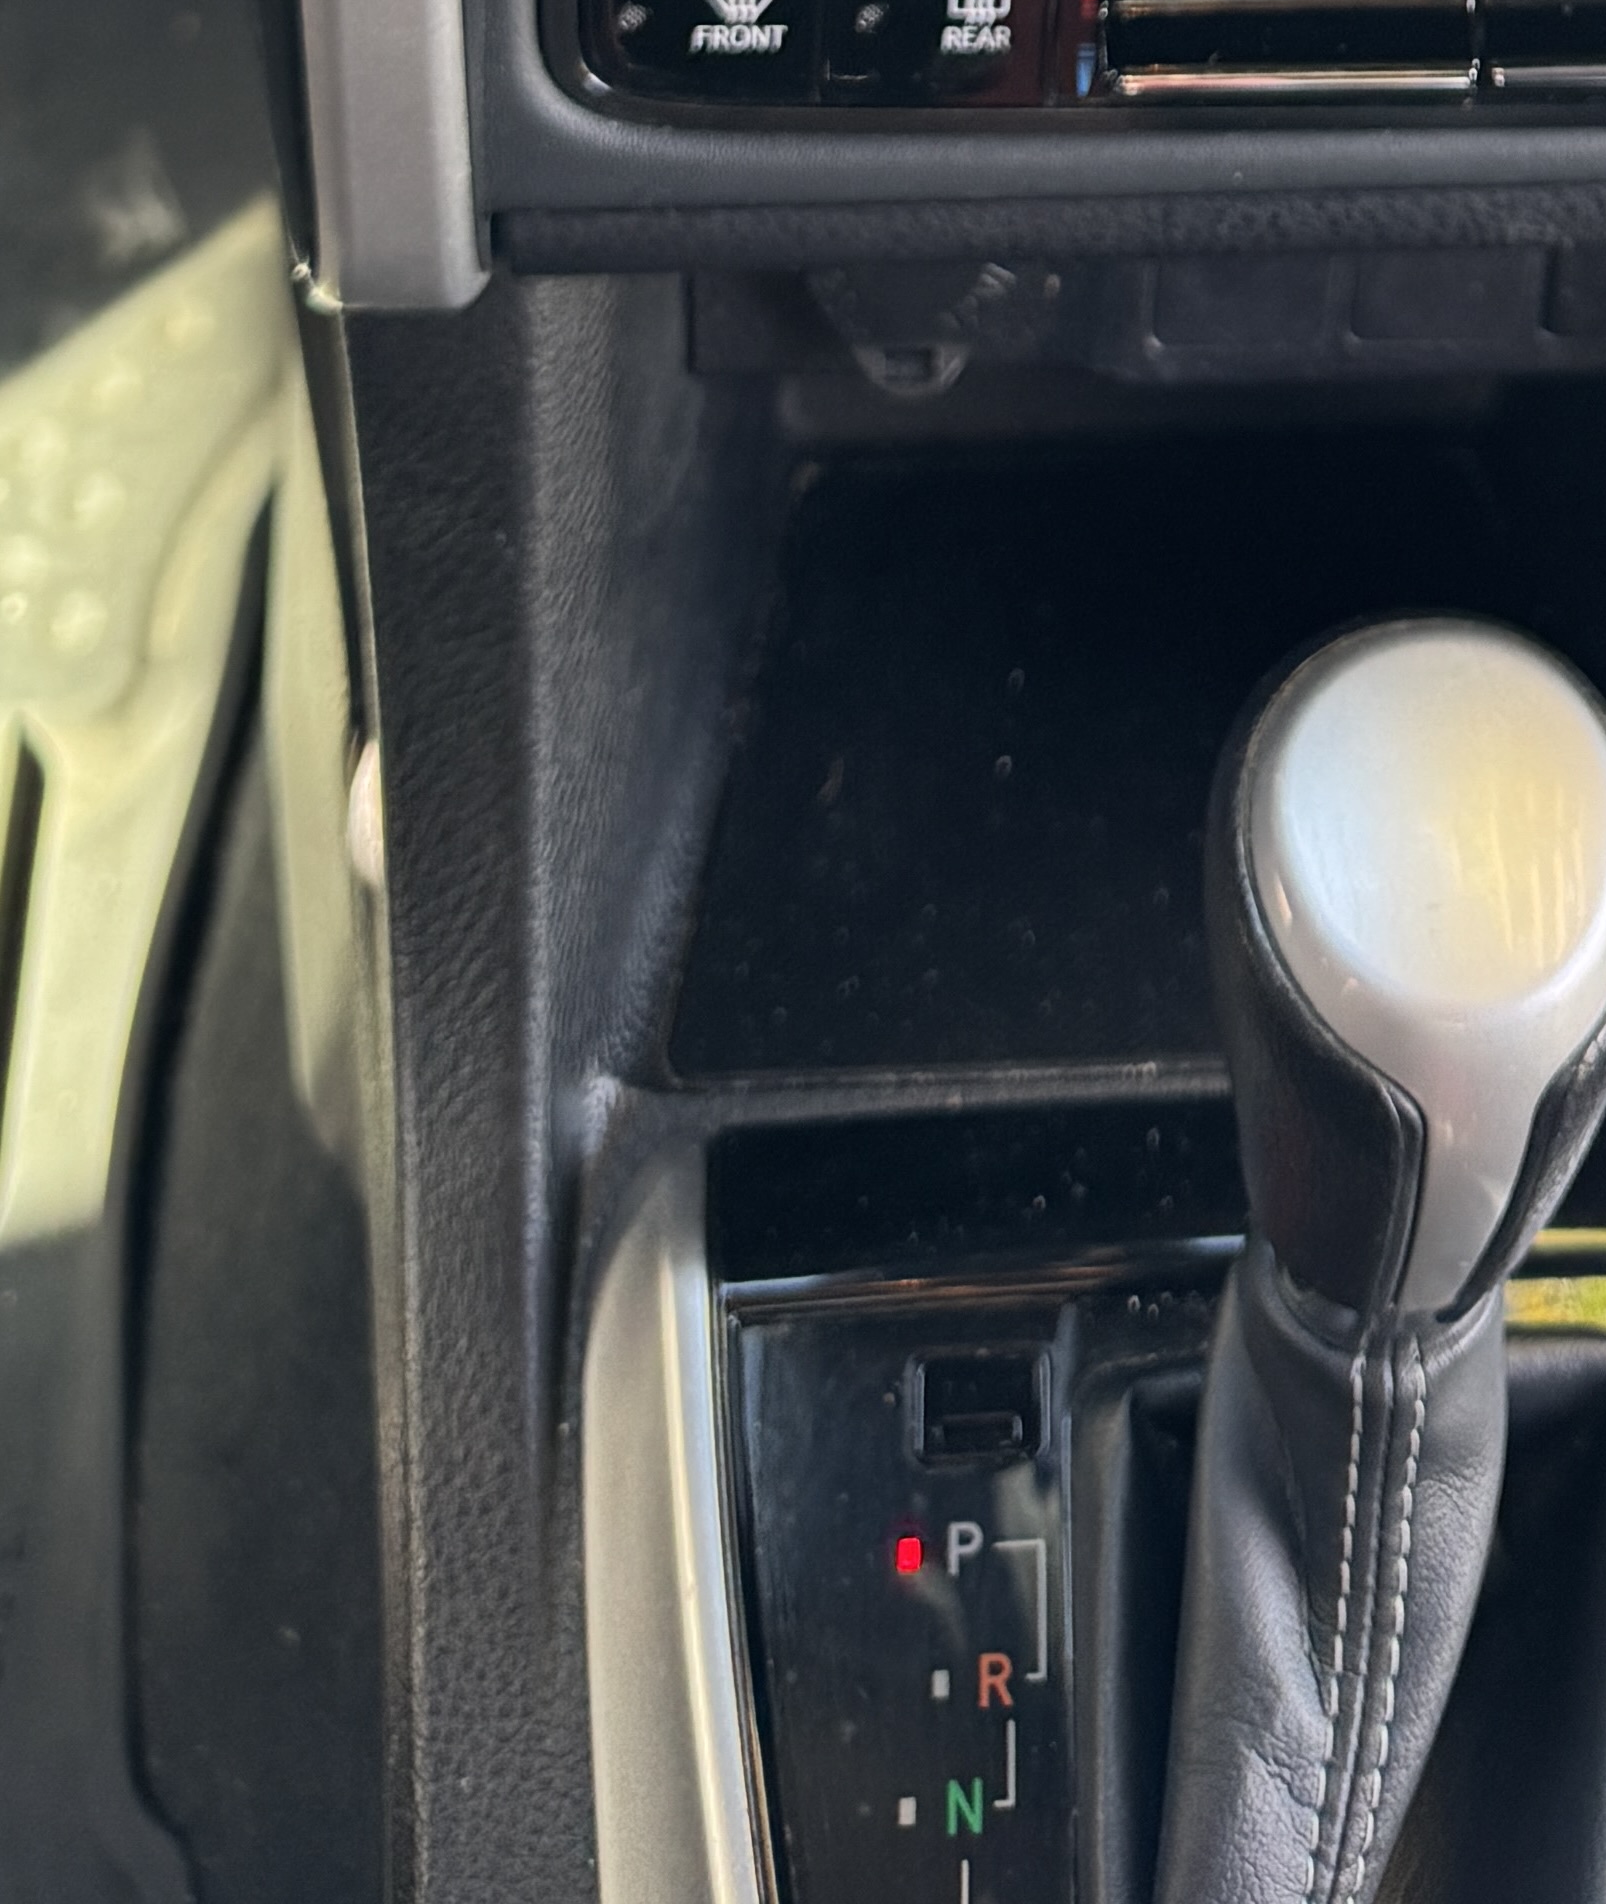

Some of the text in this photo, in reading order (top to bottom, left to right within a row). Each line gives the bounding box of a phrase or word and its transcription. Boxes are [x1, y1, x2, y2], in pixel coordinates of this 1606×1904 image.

[691, 25, 788, 51] FRONT
[942, 26, 1011, 52] REAR
[948, 1521, 983, 1576] P
[979, 1653, 1012, 1708] R
[947, 1778, 983, 1836] N
